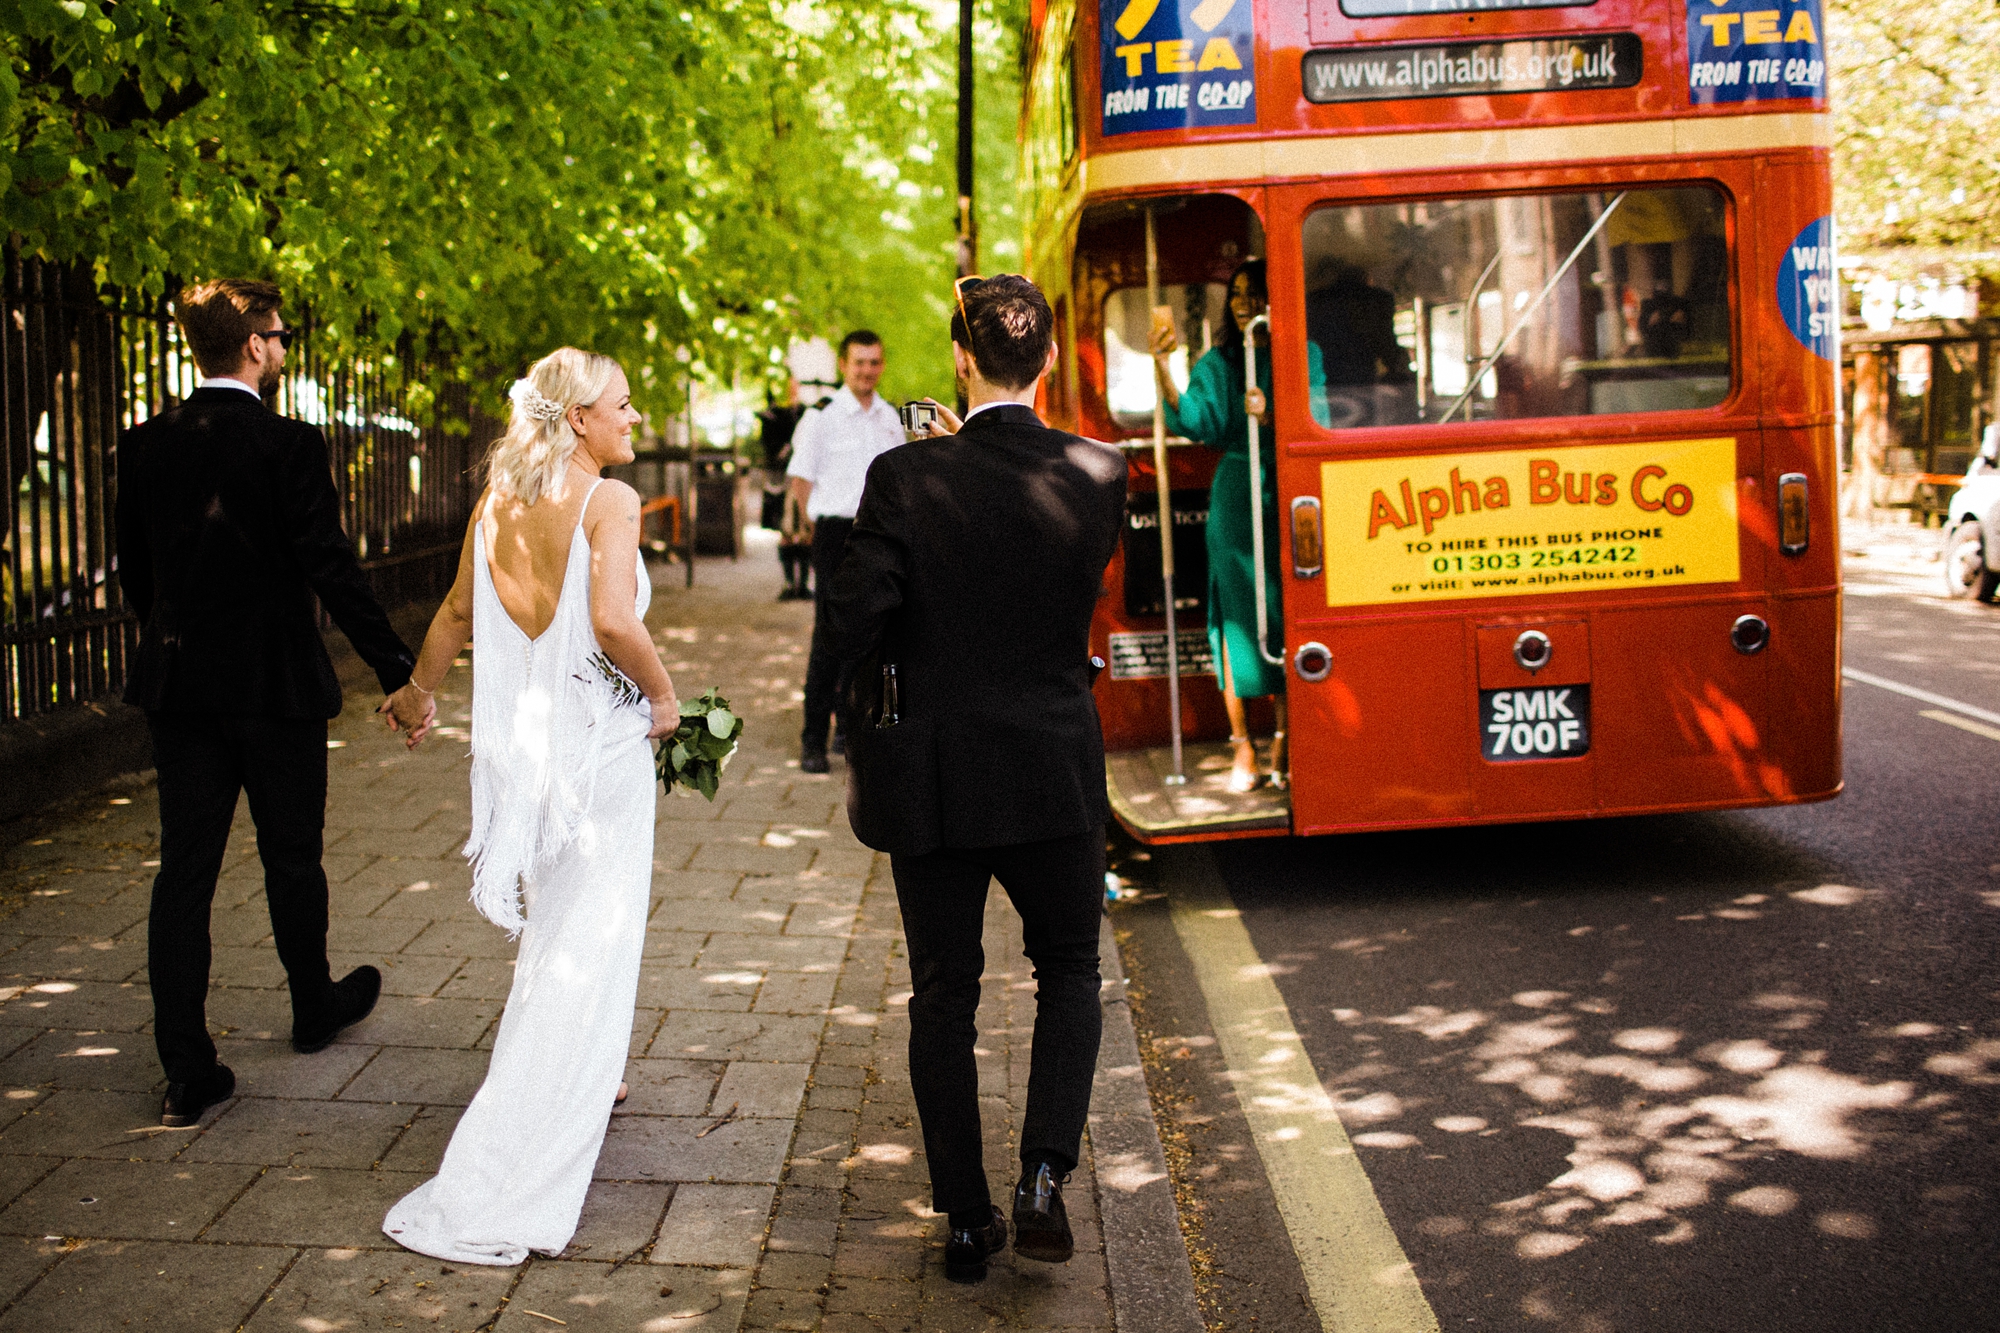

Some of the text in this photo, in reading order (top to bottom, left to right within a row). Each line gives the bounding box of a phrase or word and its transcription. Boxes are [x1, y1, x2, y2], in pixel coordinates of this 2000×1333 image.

[1700, 10, 1818, 47] TEA
[1115, 37, 1243, 77] TEA
[1314, 43, 1617, 90] www.alphabus.org.uk
[1690, 60, 1742, 87] FROM
[1747, 58, 1782, 84] THE
[1105, 80, 1253, 117] FROM THE CO-OP
[1792, 246, 1832, 271] WA
[1803, 278, 1832, 304] YO
[1366, 458, 1694, 540] Alpha Bus Co
[1406, 528, 1664, 554] TO HIRE THIS BUS PHONE
[1433, 546, 1637, 573] 01303 254242
[1391, 582, 1411, 593] or
[1472, 564, 1686, 588] www.alphabus.org.uk
[1491, 688, 1575, 723] SMK
[1487, 719, 1580, 756] 700F
